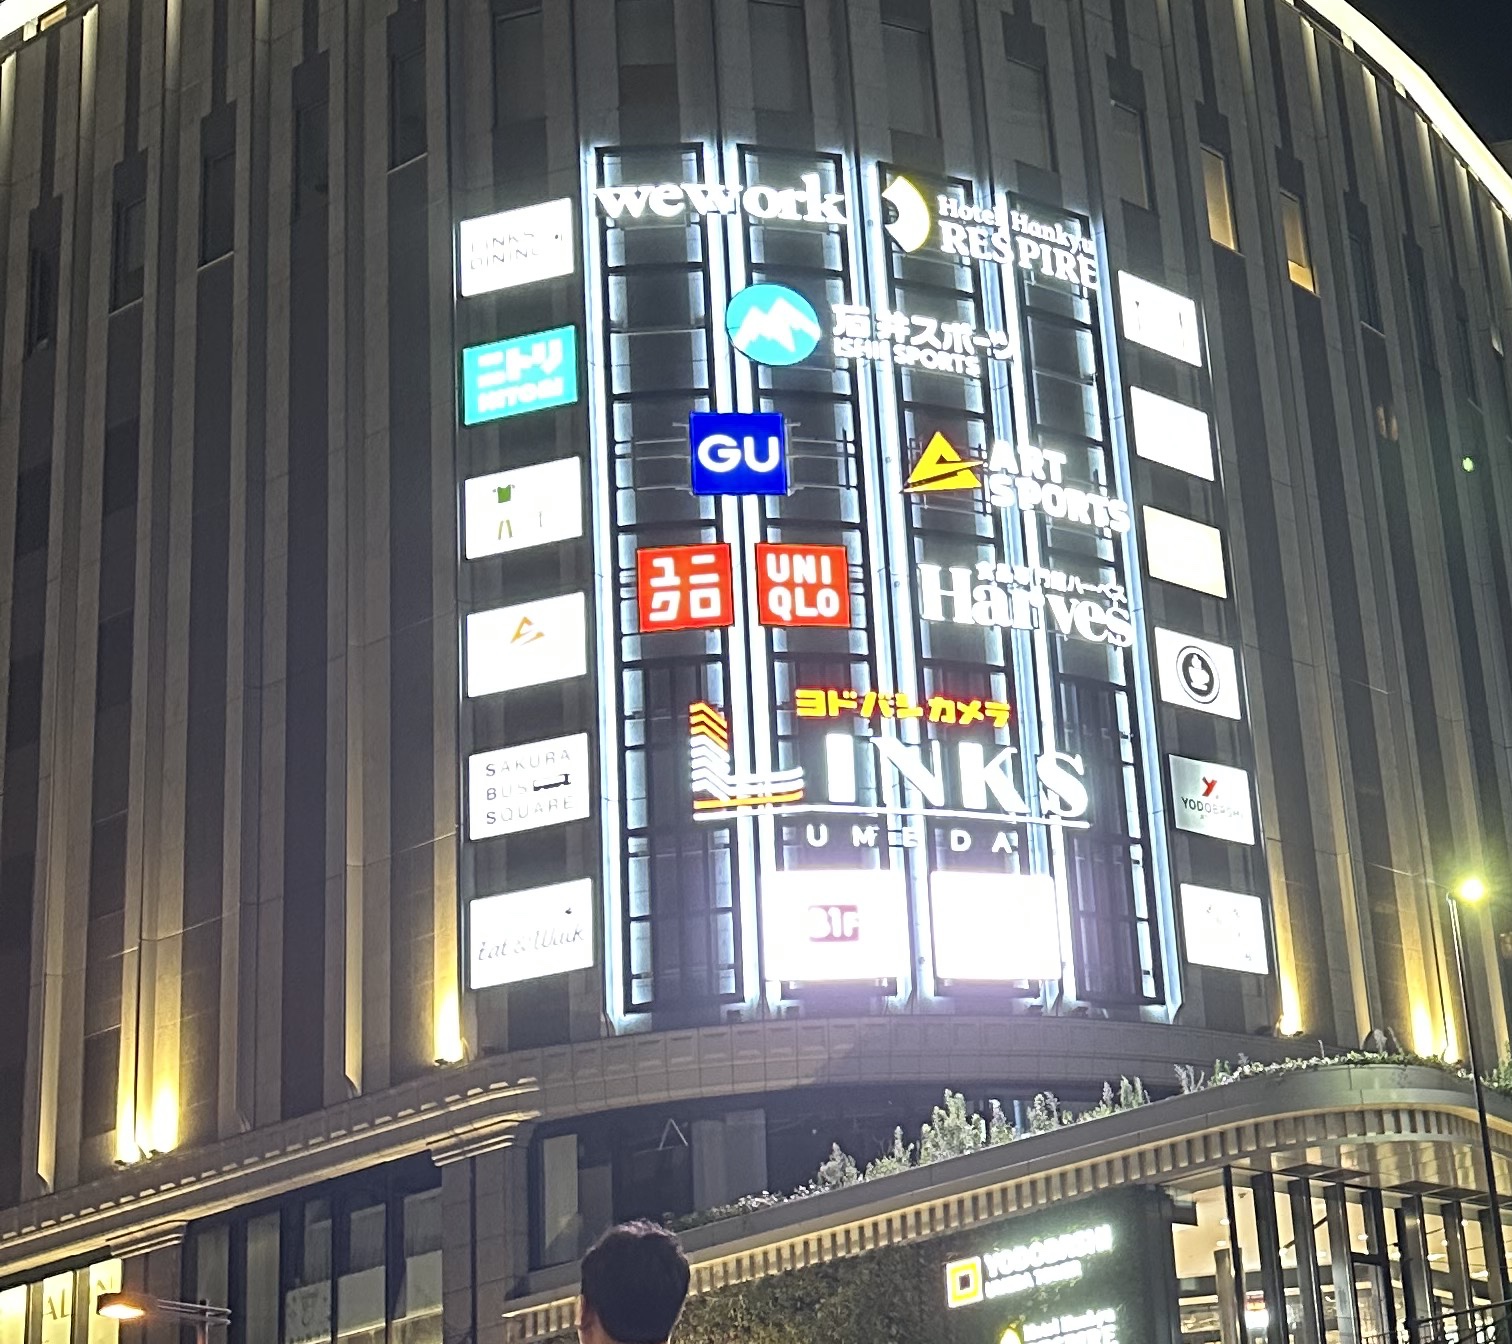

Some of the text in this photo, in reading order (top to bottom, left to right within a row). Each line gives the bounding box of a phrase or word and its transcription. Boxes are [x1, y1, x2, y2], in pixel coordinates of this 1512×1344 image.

[593, 172, 848, 224] wework
[937, 194, 1096, 256] Hotel Hankyu
[938, 219, 1099, 291] RESPIRE
[832, 304, 1014, 359] 石井スポーツ
[477, 338, 564, 389] ニトリ
[893, 342, 981, 377] SPORTS
[697, 434, 781, 473] GU
[989, 439, 1067, 484] ART
[989, 472, 1131, 534] SPORTS
[917, 563, 1135, 648] Harves
[794, 688, 1012, 729] ヨドバシカメラ
[486, 749, 571, 777] SAKURA
[486, 795, 574, 825] SQUARE
[805, 822, 1014, 854] UMEDA
